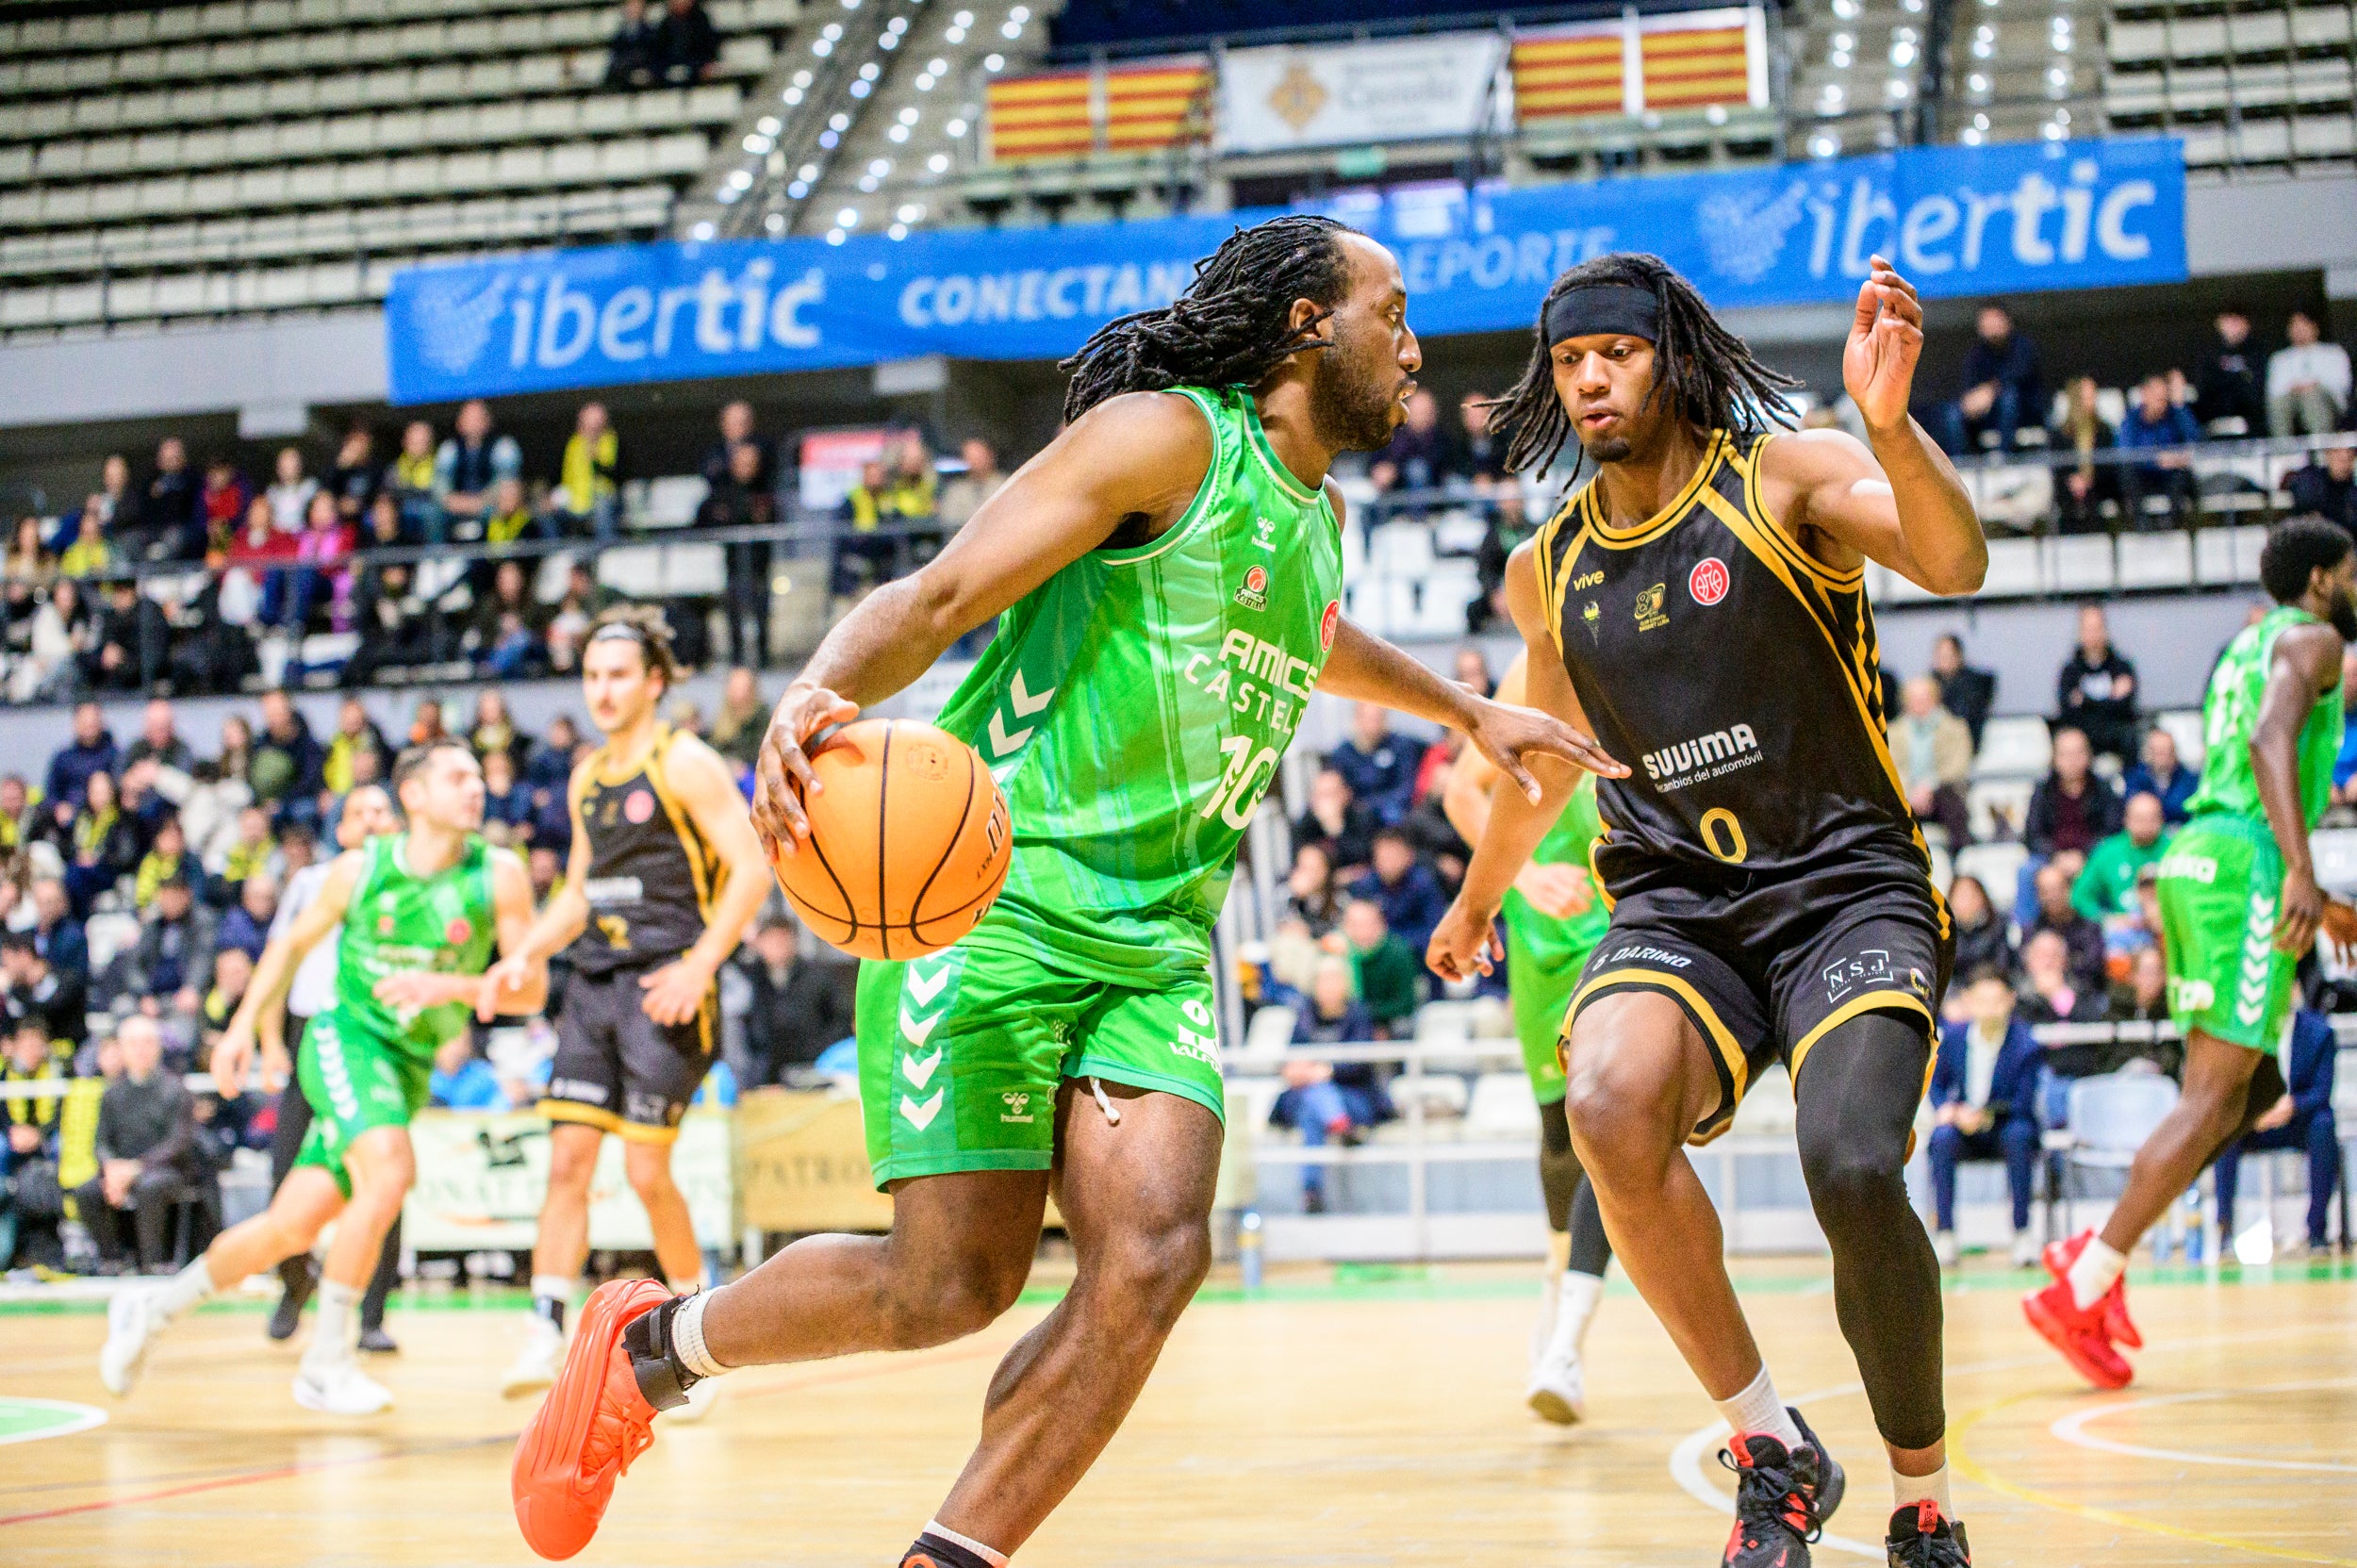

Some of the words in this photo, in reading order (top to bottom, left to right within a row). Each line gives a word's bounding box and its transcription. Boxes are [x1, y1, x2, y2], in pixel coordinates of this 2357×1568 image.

[1805, 160, 2156, 279] ibertic
[1390, 227, 1616, 293] EPORTE
[508, 256, 825, 369] ibertic
[898, 262, 1197, 328] CONECTAN
[1574, 570, 1605, 591] vive
[1218, 629, 1318, 701] AMICS
[1200, 735, 1280, 830] 10
[1694, 769, 1710, 783] del
[1712, 751, 1764, 778] automóvil
[1700, 808, 1747, 864] 0
[1610, 947, 1692, 968] DARIMO
[750, 1156, 869, 1187] PATRO
